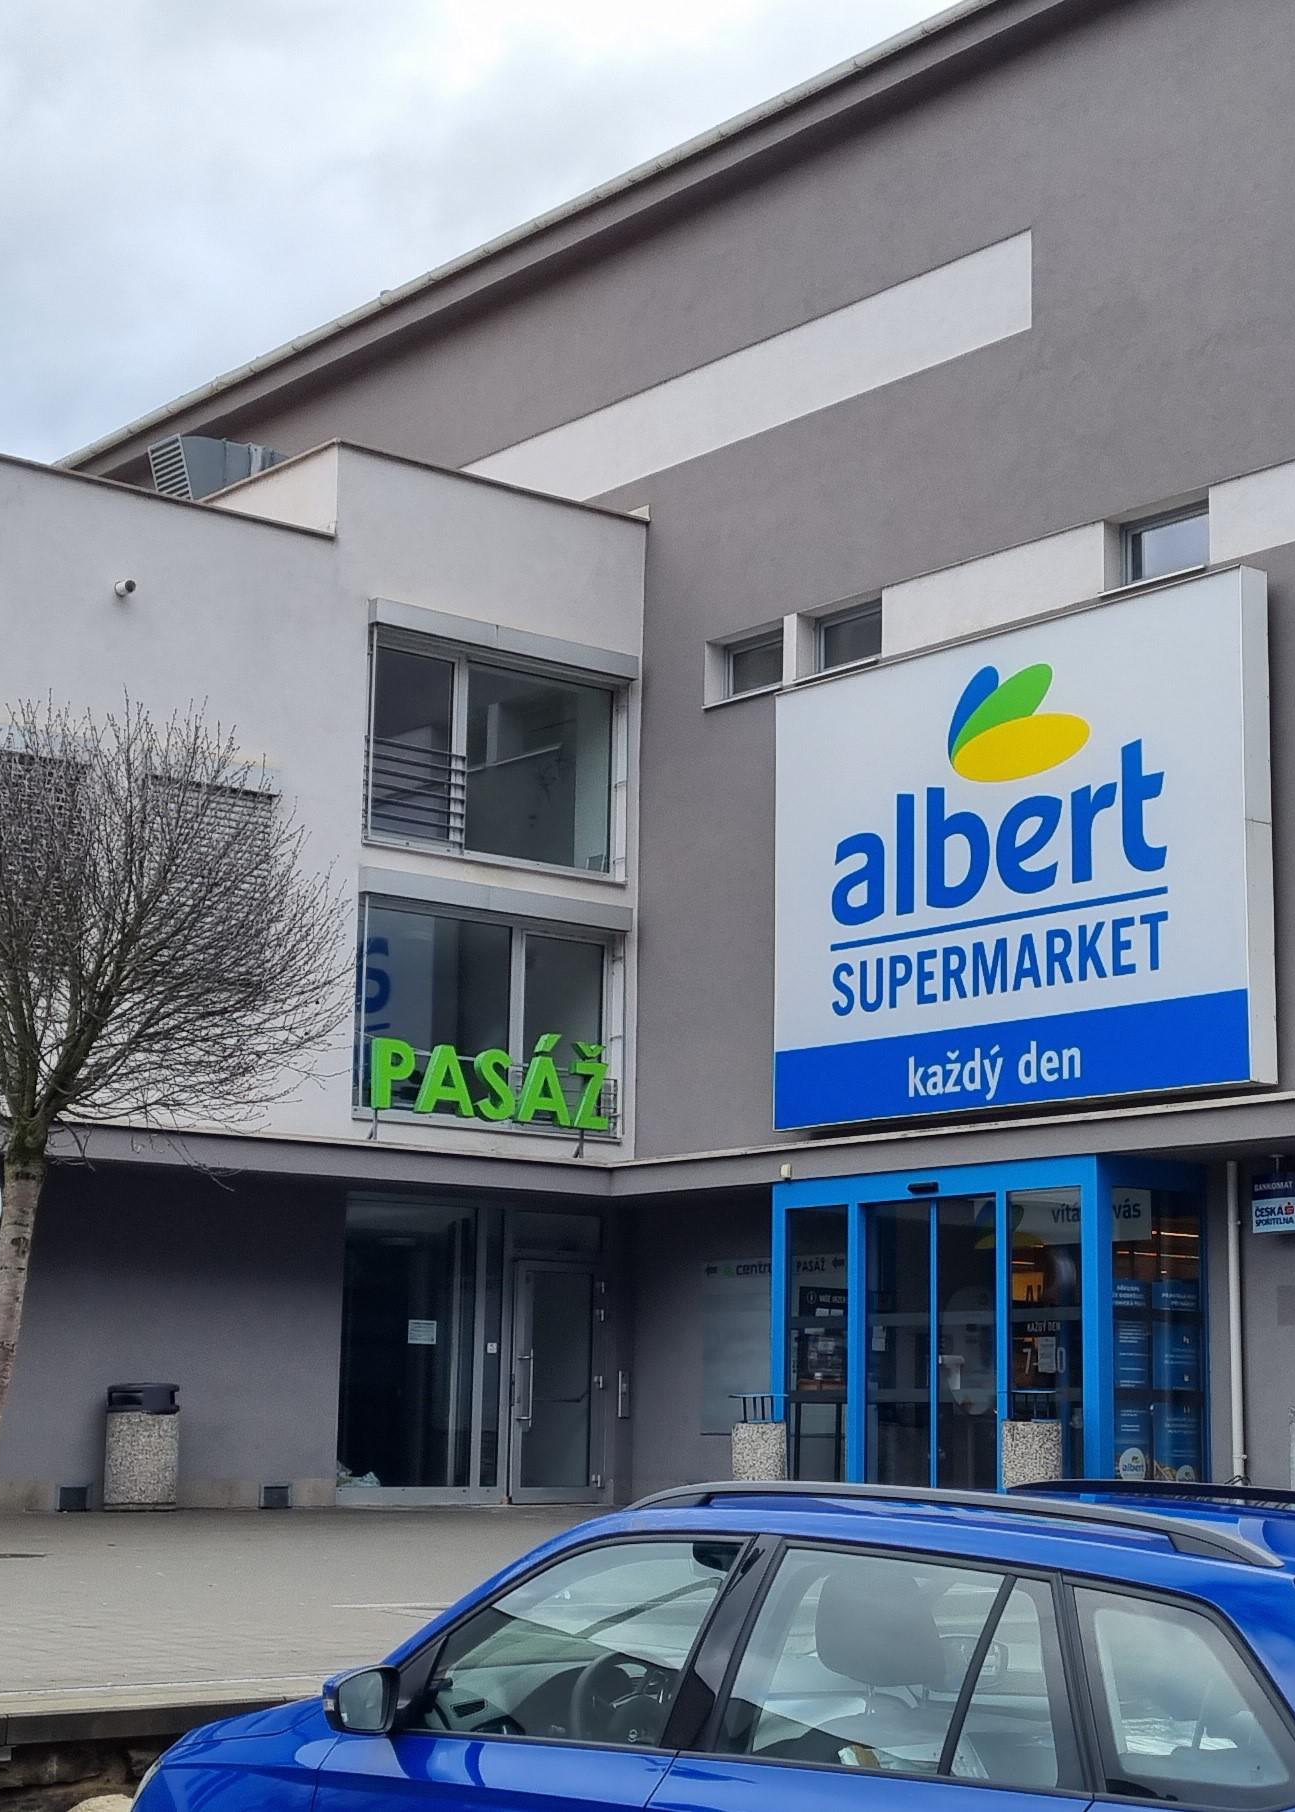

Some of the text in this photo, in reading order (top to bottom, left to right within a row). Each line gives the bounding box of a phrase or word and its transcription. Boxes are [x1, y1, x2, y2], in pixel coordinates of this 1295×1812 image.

[830, 738, 1168, 926] albert
[831, 910, 1169, 1017] SUPERMARKET
[370, 1033, 610, 1131] PASÁŽ
[907, 1040, 1082, 1100] každý den
[1051, 1198, 1142, 1224] vítá vás
[1254, 1203, 1284, 1218] ČESKÁ
[735, 1262, 772, 1276] centr
[796, 1256, 826, 1273] PASÁŽ
